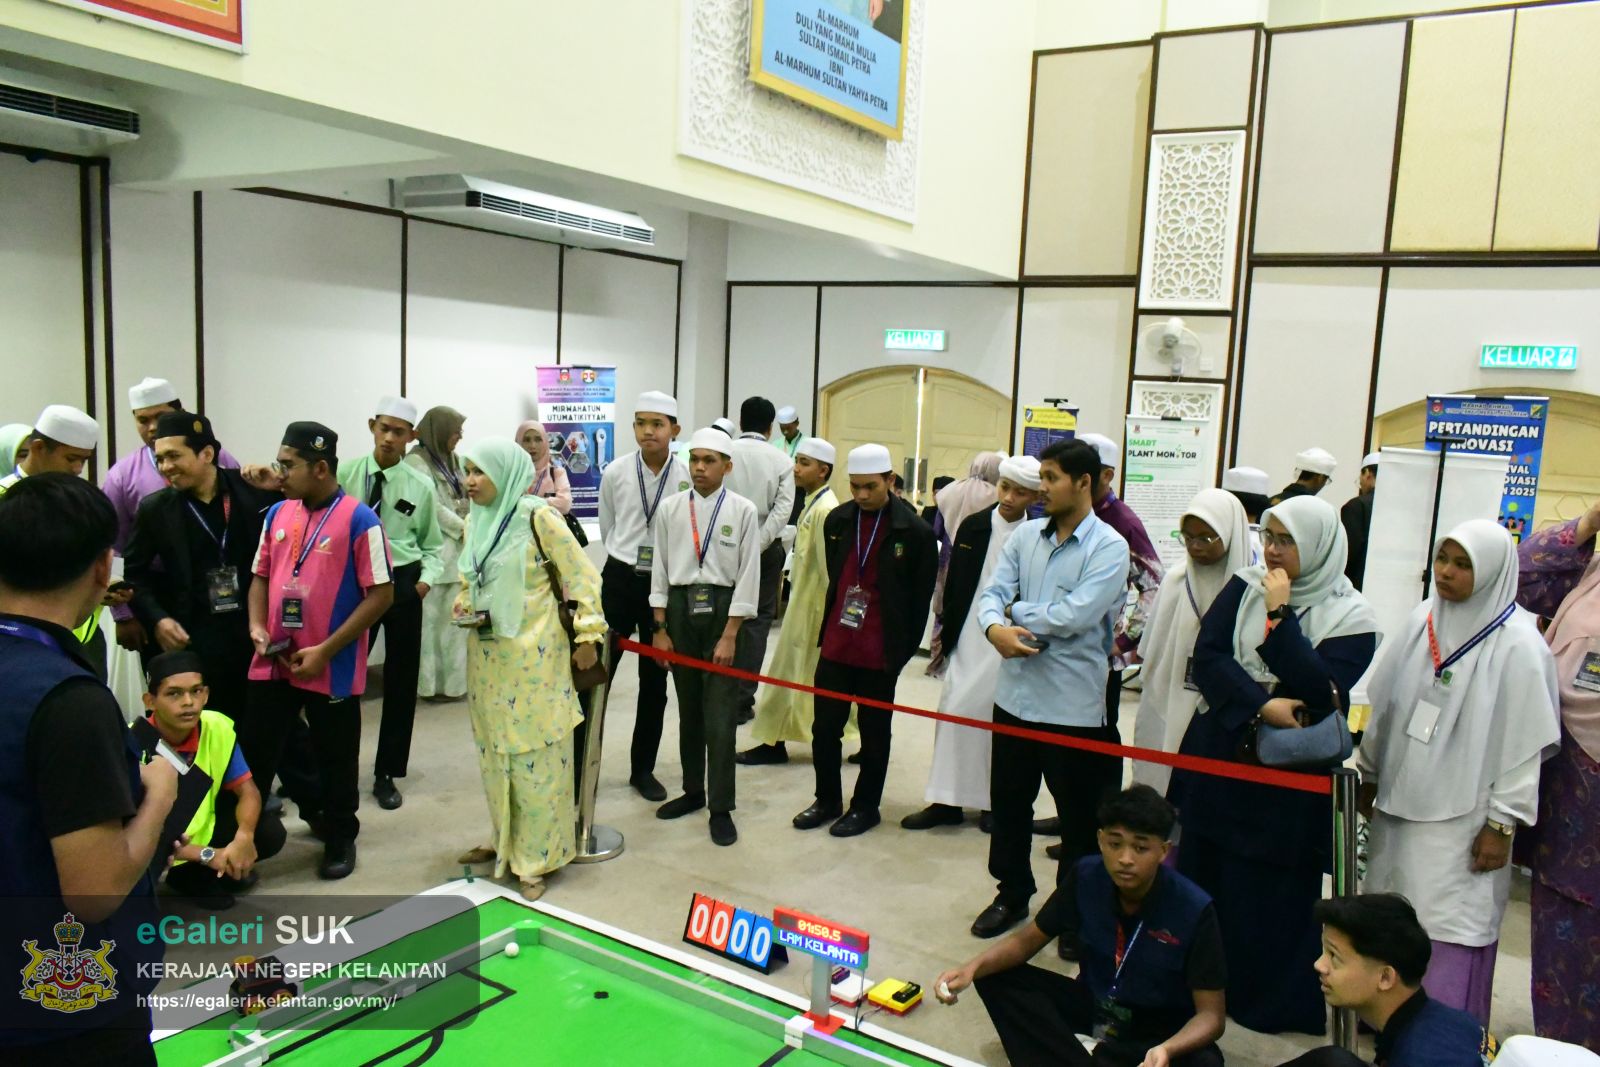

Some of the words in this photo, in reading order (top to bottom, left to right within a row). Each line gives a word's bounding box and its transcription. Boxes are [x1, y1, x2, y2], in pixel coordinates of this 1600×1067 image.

[817, 8, 859, 39] AL-MARHUM
[795, 12, 813, 31] DULI
[814, 21, 834, 41] YANG
[835, 33, 855, 52] MAHA
[856, 43, 877, 64] MULIA
[799, 30, 826, 53] SULTAN
[827, 43, 850, 64] ISMAIL
[851, 55, 871, 75] PETRA
[774, 50, 821, 81] AL-MARHUM
[822, 72, 847, 93] SULTAN
[848, 84, 869, 103] YAHYA
[869, 93, 888, 112] PETRA
[829, 60, 844, 77] IBNI
[1484, 346, 1556, 367] KELUAR
[1428, 421, 1539, 438] PERTANDINGAN
[1509, 487, 1535, 496] 2025
[798, 920, 842, 942] 01:50.5
[779, 929, 803, 947] LAM
[804, 937, 859, 965] KELANTA
